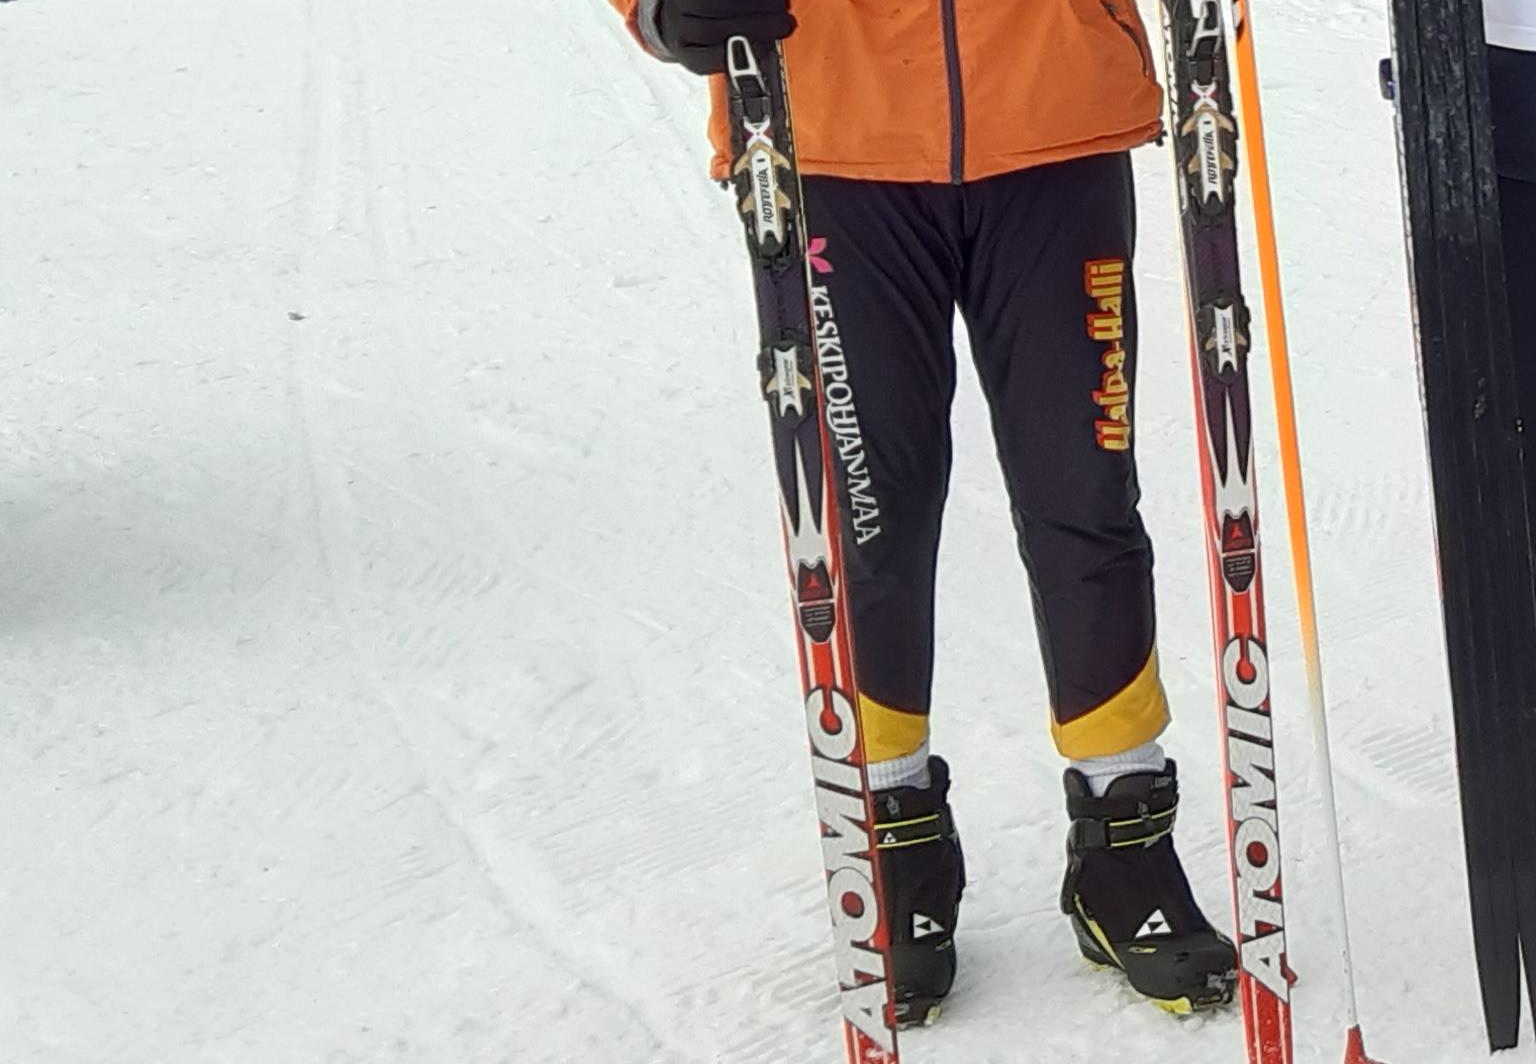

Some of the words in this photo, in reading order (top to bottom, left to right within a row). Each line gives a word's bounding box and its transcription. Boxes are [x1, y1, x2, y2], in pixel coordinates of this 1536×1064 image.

[810, 285, 881, 545] KESKIPOHJANMAA
[805, 684, 896, 1057] ATOMIC
[1221, 635, 1291, 1007] ATOMIC
